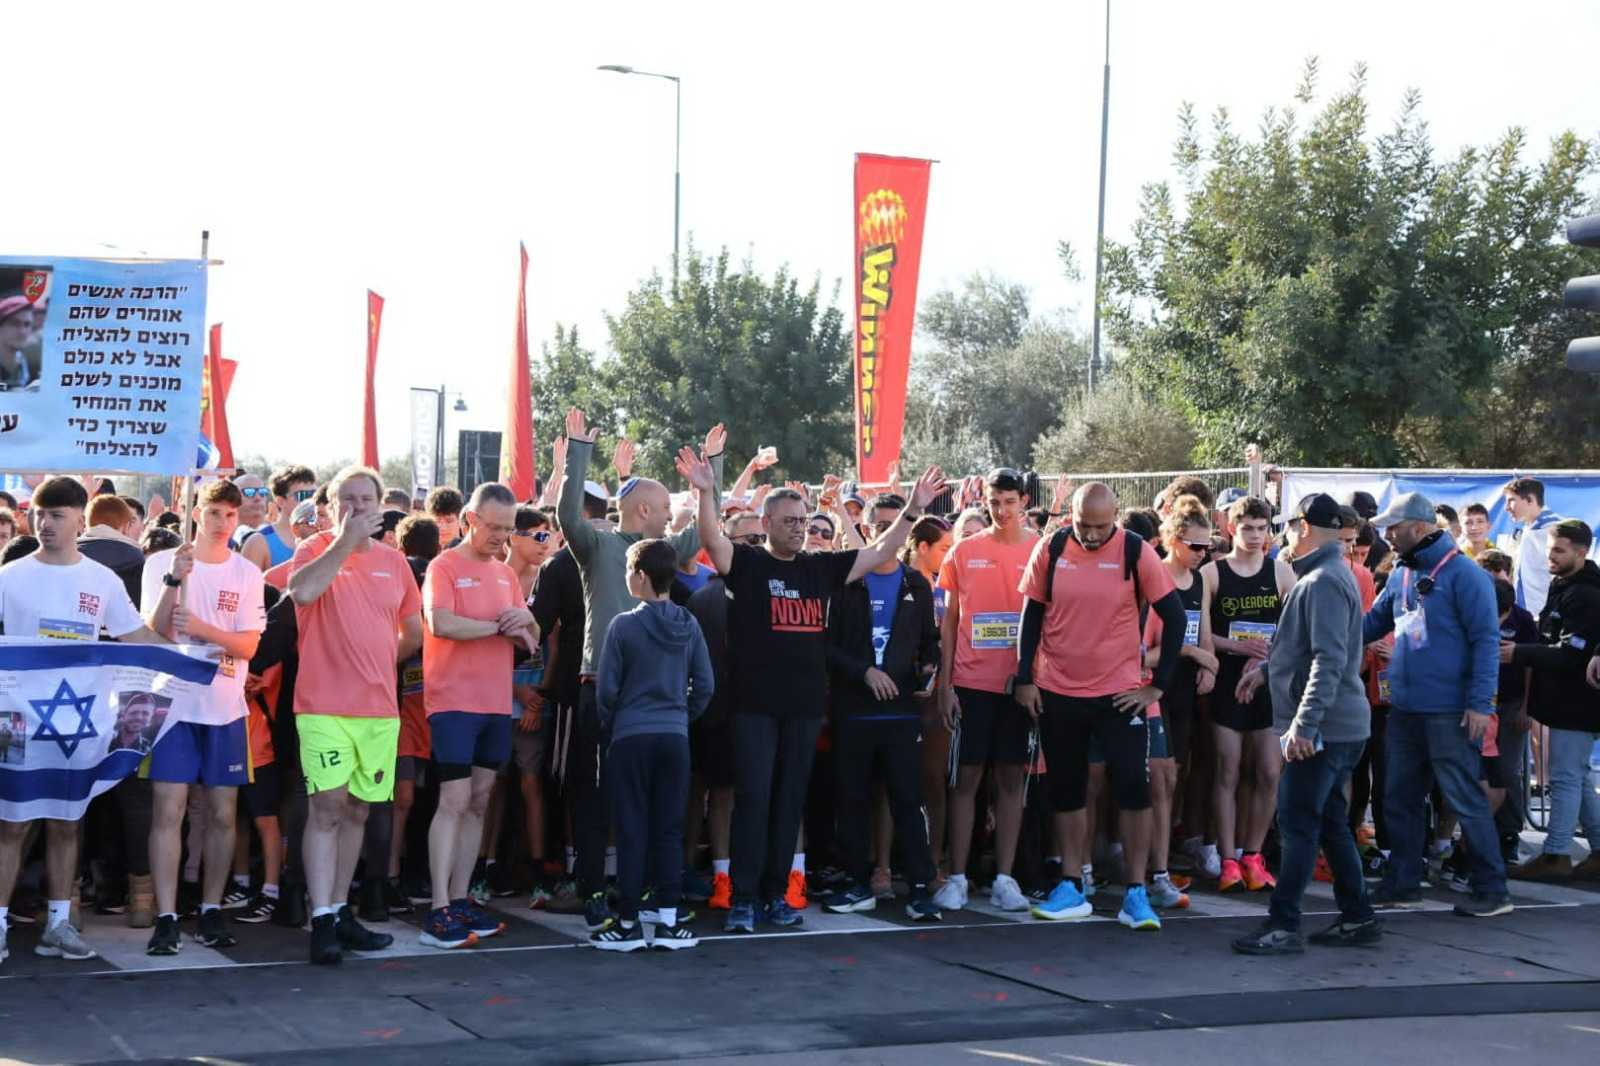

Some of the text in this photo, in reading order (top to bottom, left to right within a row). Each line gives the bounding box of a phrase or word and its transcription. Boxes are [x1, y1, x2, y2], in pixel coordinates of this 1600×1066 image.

[67, 284, 125, 299] אנשים
[69, 306, 183, 322] אומרים שהם
[137, 330, 190, 345] רוצים
[64, 348, 182, 368] אבל לא כולם
[60, 371, 182, 391] מוכנים לשלם
[72, 396, 167, 412] את המחיר
[67, 418, 168, 436] שצריך כדי
[1240, 595, 1275, 609] LEADER
[771, 597, 823, 625] NOW!
[319, 750, 342, 769] 12
